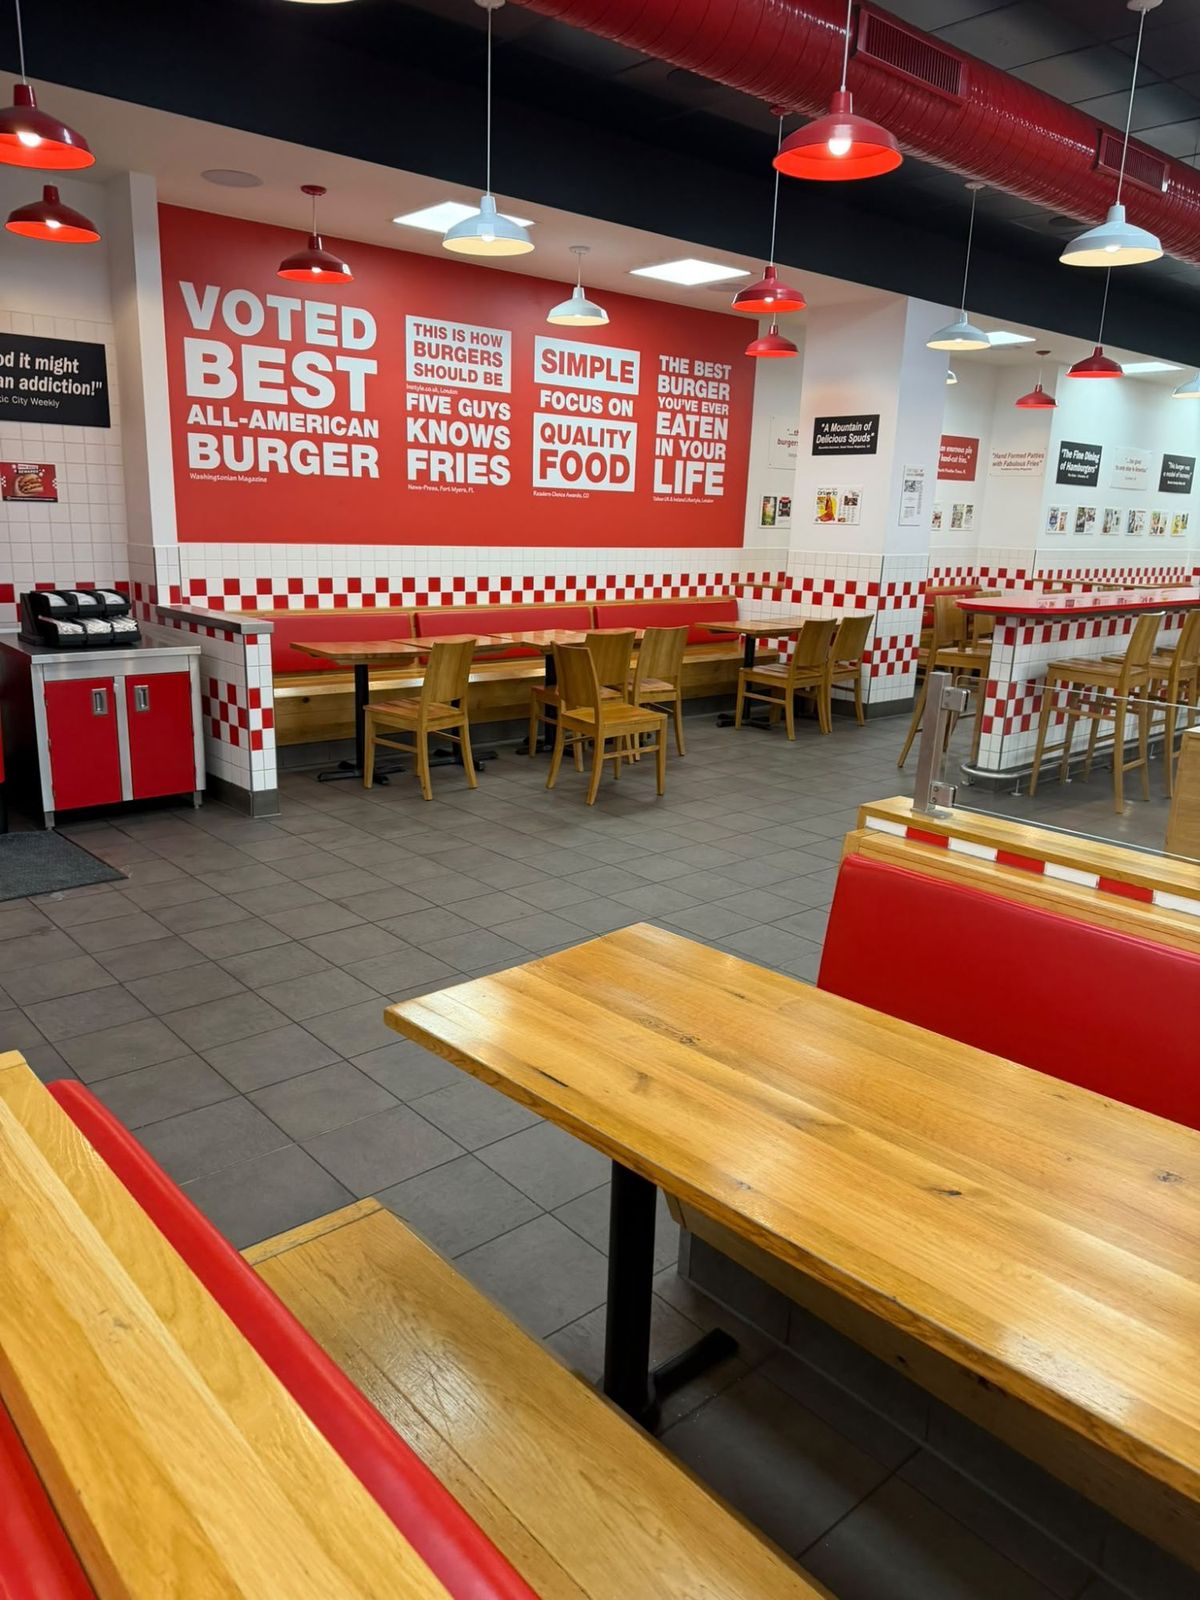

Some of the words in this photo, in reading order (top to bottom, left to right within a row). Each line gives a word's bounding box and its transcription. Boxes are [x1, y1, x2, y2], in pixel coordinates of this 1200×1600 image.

[179, 280, 377, 350] VOTED
[413, 322, 447, 340] THIS
[452, 329, 466, 343] IS
[470, 331, 503, 348] HOW
[19, 352, 31, 369] it
[35, 355, 79, 375] might
[413, 340, 503, 368] BURGERS
[541, 348, 634, 384] SIMPLE
[659, 354, 690, 374] THE
[694, 360, 732, 380] BEST
[19, 376, 102, 396] addiction!"
[183, 337, 378, 412] BEST
[413, 362, 478, 383] SHOULD
[483, 371, 503, 386] BE
[657, 374, 731, 401] BURGER
[12, 395, 28, 406] City
[30, 397, 60, 408] Weekly
[406, 392, 452, 415] FIVE
[458, 398, 511, 421] GUYS
[540, 389, 603, 414] FOCUS
[608, 398, 633, 417] ON
[658, 396, 698, 412] YOU'VE
[702, 401, 729, 415] EVER
[187, 404, 379, 439] ALL-AMERICAN
[406, 417, 511, 450] KNOWS
[656, 411, 728, 440] EATEN
[830, 421, 862, 432] Mountain
[863, 421, 872, 431] of
[540, 422, 631, 449] QUALITY
[655, 437, 673, 457] IN
[679, 439, 726, 460] YOUR
[816, 434, 847, 444] Delicious
[187, 432, 380, 479] BURGER
[407, 448, 511, 486] FRIES
[539, 448, 630, 484] FOOD
[1060, 461, 1067, 471] of
[1073, 449, 1084, 460] Fine
[1084, 451, 1100, 464] Dining
[190, 473, 237, 482] Washingtonian
[238, 475, 268, 483] Magazine
[653, 458, 725, 496] LIFE
